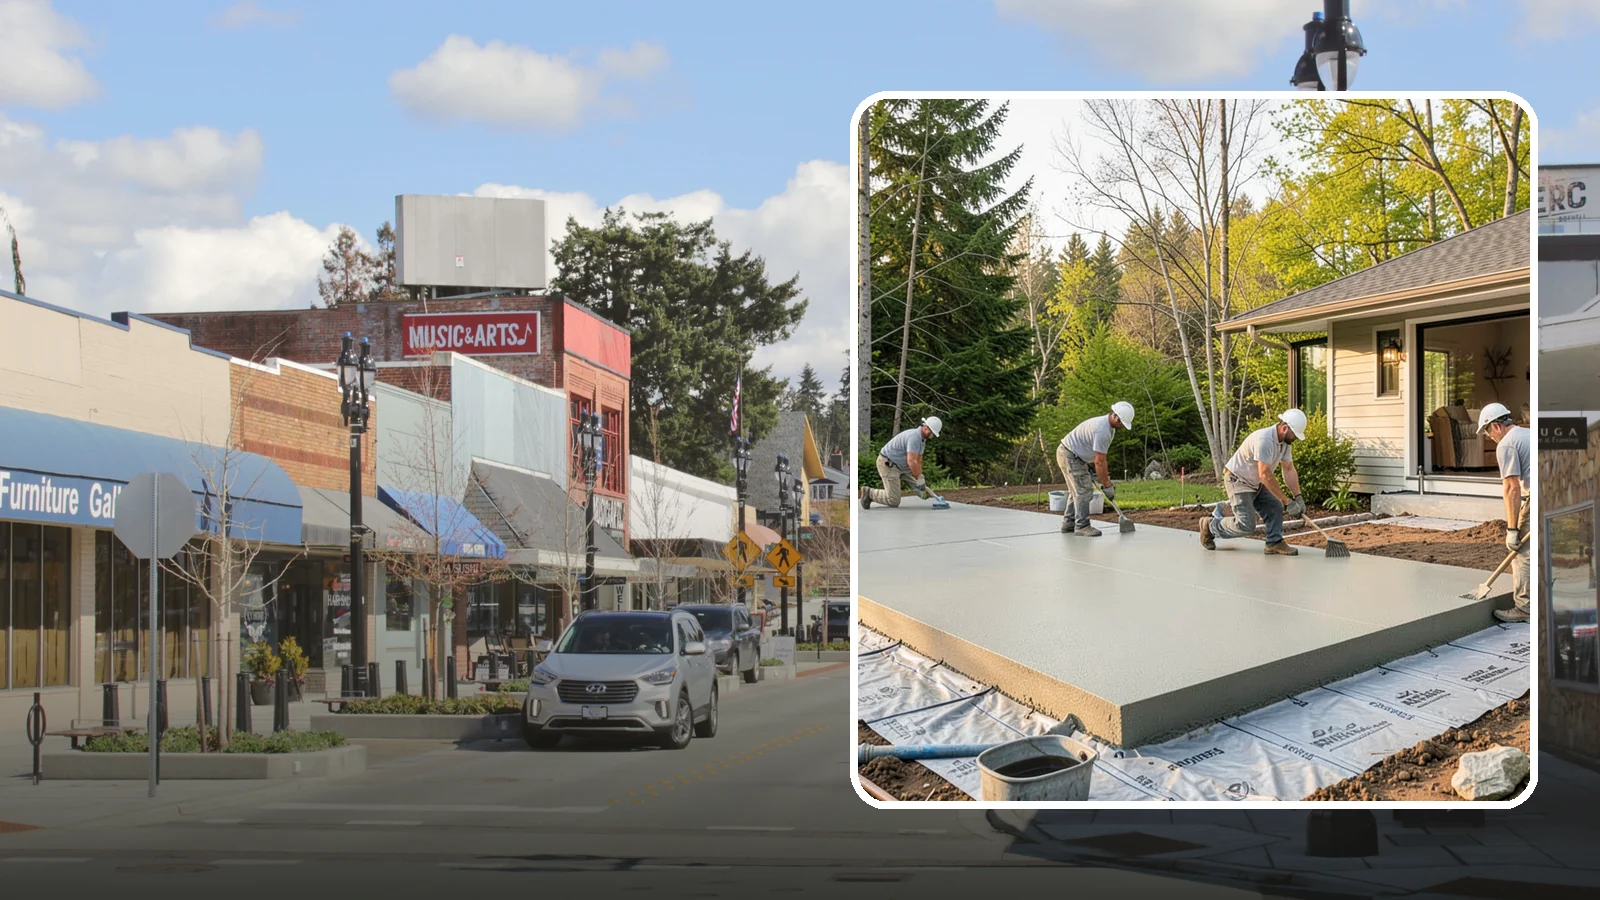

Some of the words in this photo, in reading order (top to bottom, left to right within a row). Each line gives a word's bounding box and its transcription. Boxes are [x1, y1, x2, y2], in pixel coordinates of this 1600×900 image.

[1540, 427, 1577, 436] UGA
[0, 471, 79, 515] Furniture
[89, 482, 121, 519] Gal
[453, 563, 479, 573] SUSHI
